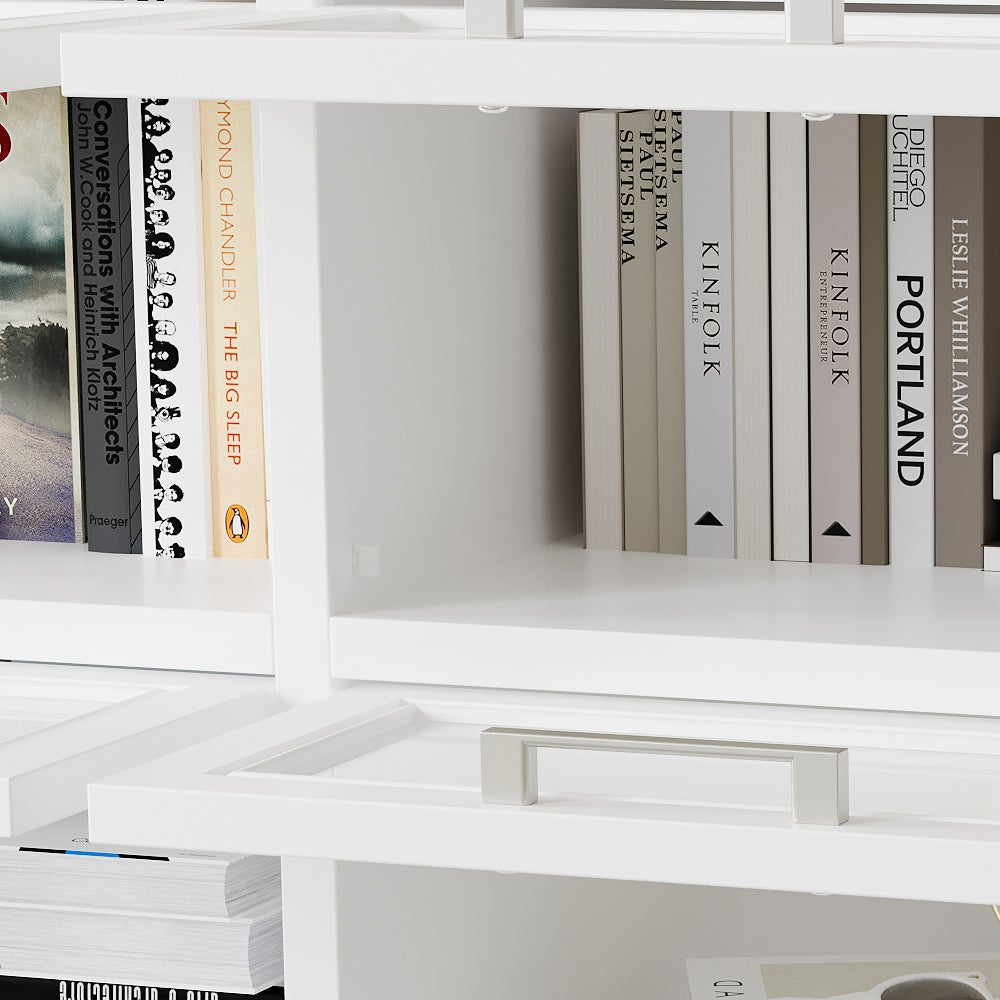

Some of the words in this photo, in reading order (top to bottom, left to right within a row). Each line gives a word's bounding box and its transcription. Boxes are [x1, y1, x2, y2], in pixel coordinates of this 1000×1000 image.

[77, 102, 92, 150] John
[216, 99, 234, 180] YMOND
[671, 111, 683, 183] PAUL
[79, 156, 96, 232] W.Cook
[93, 100, 116, 278] Conversations
[619, 129, 636, 266] SIETSEMA
[639, 130, 654, 201] PAUL
[653, 109, 669, 252] SIETSEMA
[892, 114, 909, 222] UCHITEL
[909, 128, 926, 208] DIEGO
[83, 237, 97, 275] and
[218, 187, 238, 302] CHANDLER
[951, 218, 969, 289] LESLIE
[84, 283, 98, 361] Heinrich
[100, 284, 120, 335] with
[223, 321, 239, 362] THE
[691, 290, 699, 324] TABLE
[701, 241, 721, 377] KINFOLK
[819, 271, 829, 363] ENTREPRENEUR
[830, 248, 850, 385] KINFOLK
[87, 368, 101, 412] Klotz
[102, 343, 124, 466] Architects
[224, 369, 240, 402] BIG
[896, 275, 925, 487] PORTLAND
[951, 296, 969, 457] WHILLIAMSON
[226, 410, 242, 466] SLEEP
[89, 514, 129, 529] Praeger
